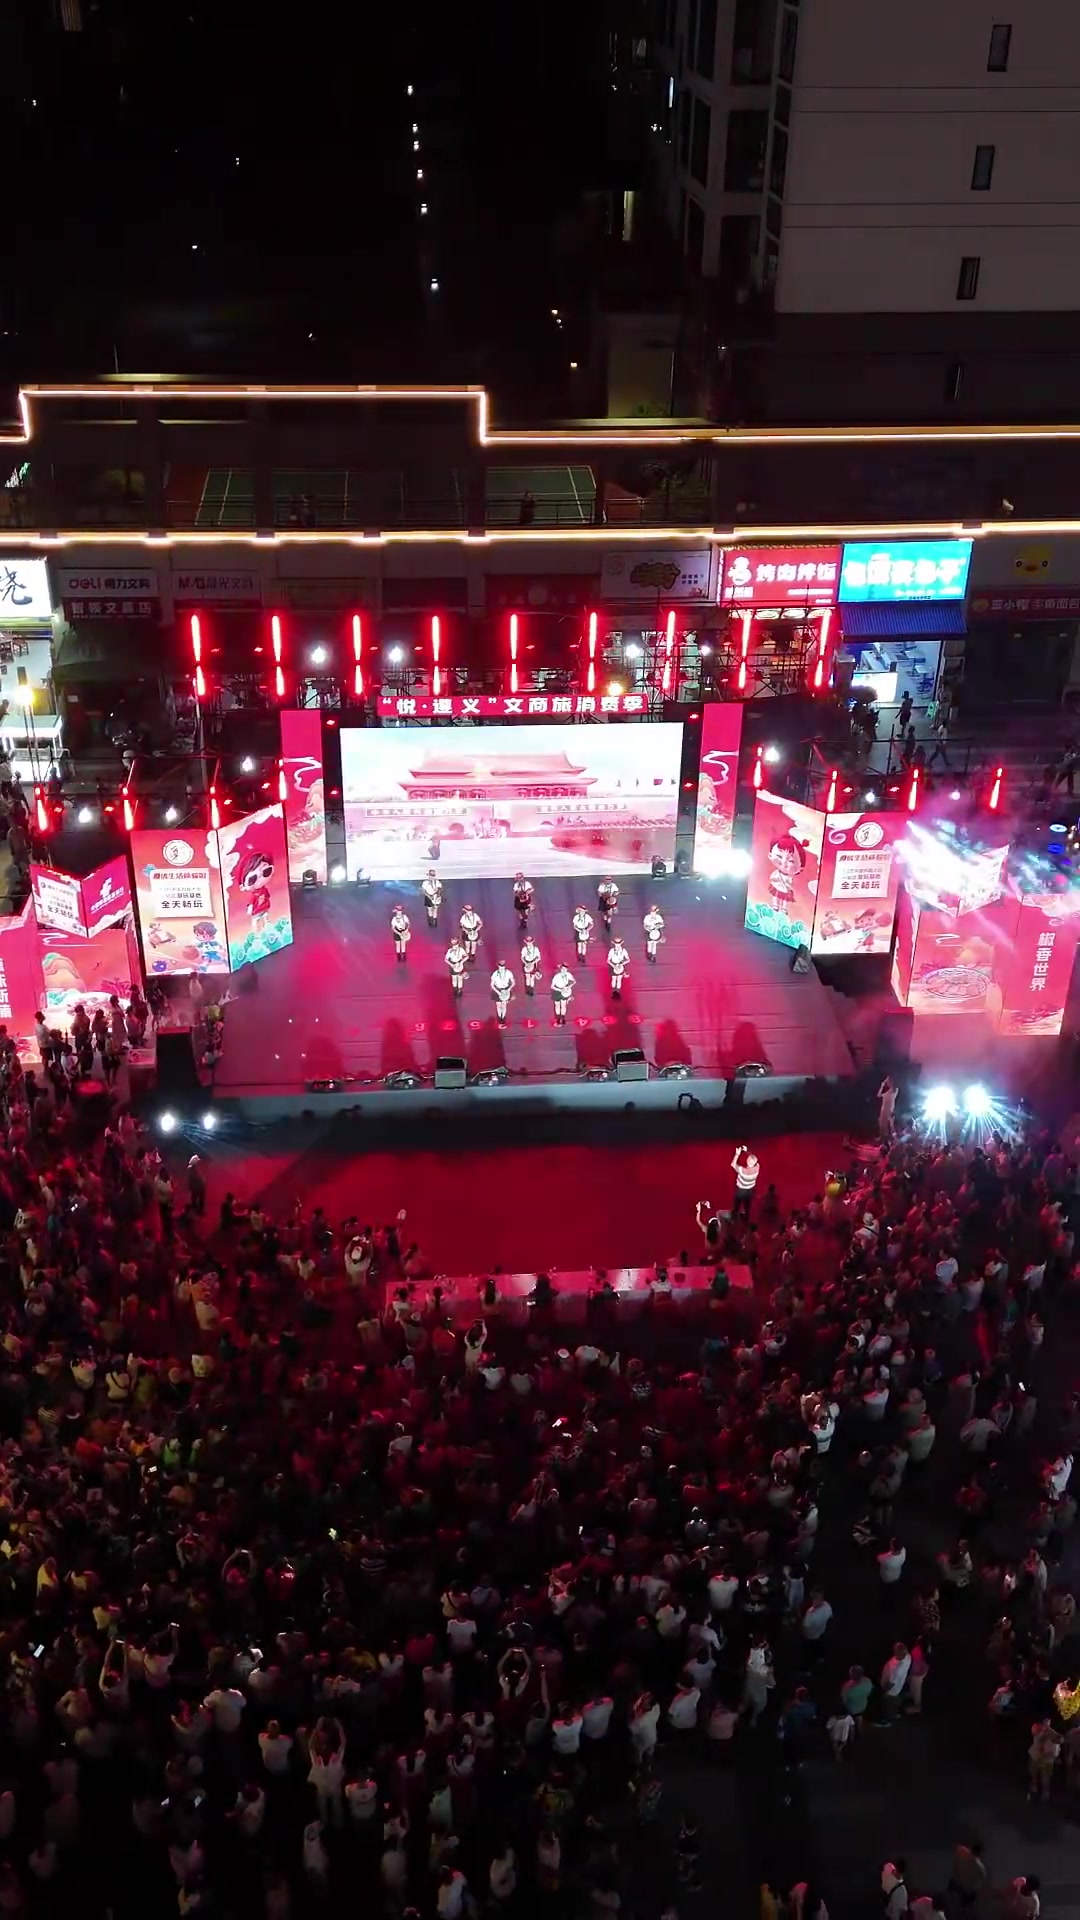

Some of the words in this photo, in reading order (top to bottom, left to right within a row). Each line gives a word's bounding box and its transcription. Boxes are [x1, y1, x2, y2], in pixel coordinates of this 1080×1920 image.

[840, 881, 880, 890] 全天畅玩
[161, 900, 204, 909] 全天畅玩
[1029, 932, 1056, 992] 椒香世界
